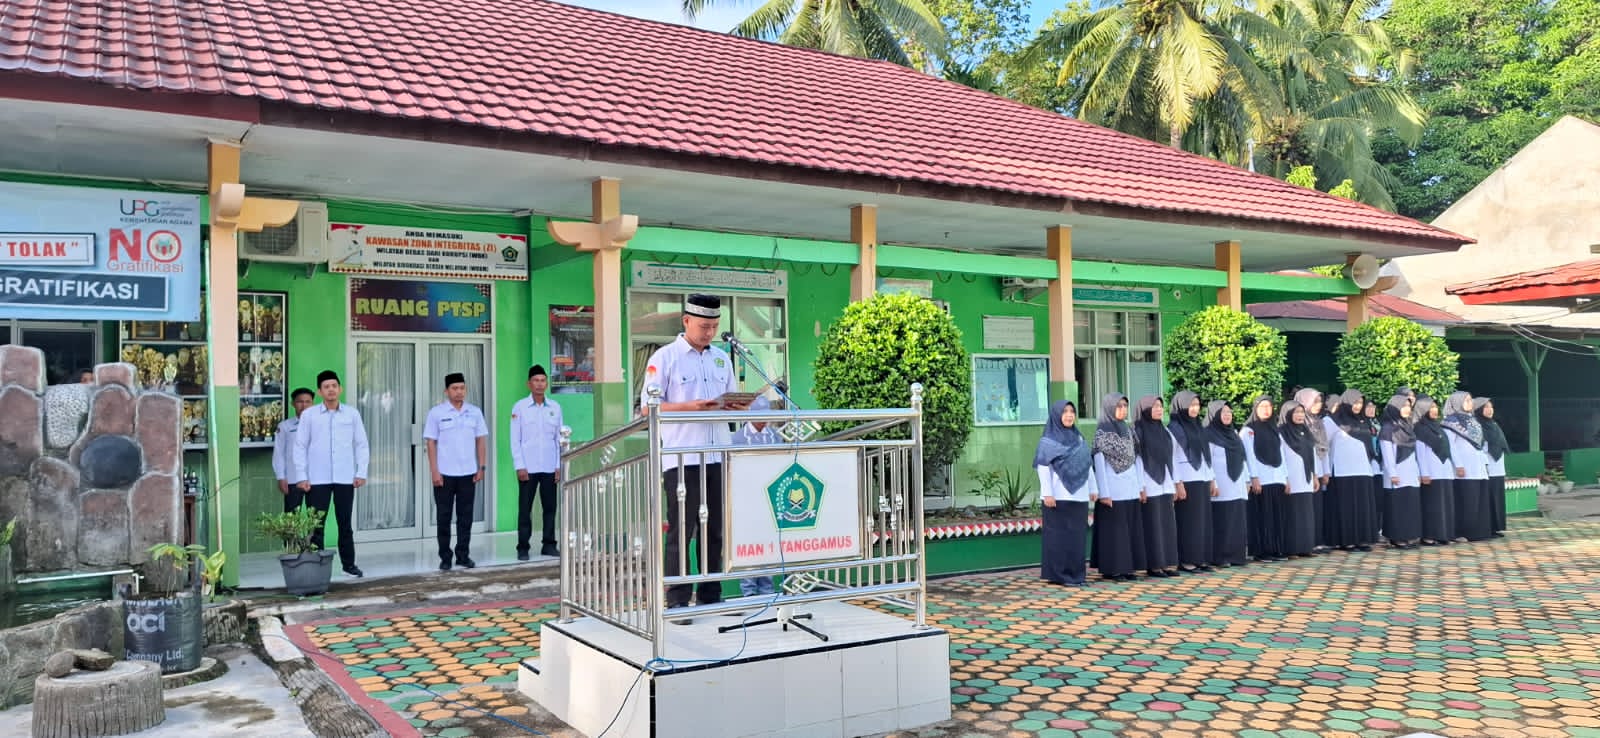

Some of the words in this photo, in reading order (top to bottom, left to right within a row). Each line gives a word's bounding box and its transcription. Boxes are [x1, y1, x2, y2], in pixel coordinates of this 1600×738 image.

[120, 198, 160, 217] UPG
[7, 241, 67, 257] TOLAK
[366, 236, 409, 247] KAWASAN
[410, 238, 433, 248] ZONA
[434, 239, 481, 251] INTEGRITAS
[482, 243, 497, 254] (ZI)
[107, 259, 184, 273] Gratifikasi
[0, 276, 139, 300] RATIFIKASI
[355, 298, 430, 317] RUANG
[437, 301, 486, 318] PTSP
[737, 543, 764, 557] MAN
[768, 541, 774, 554] 1
[780, 535, 853, 553] TANGGAMUS
